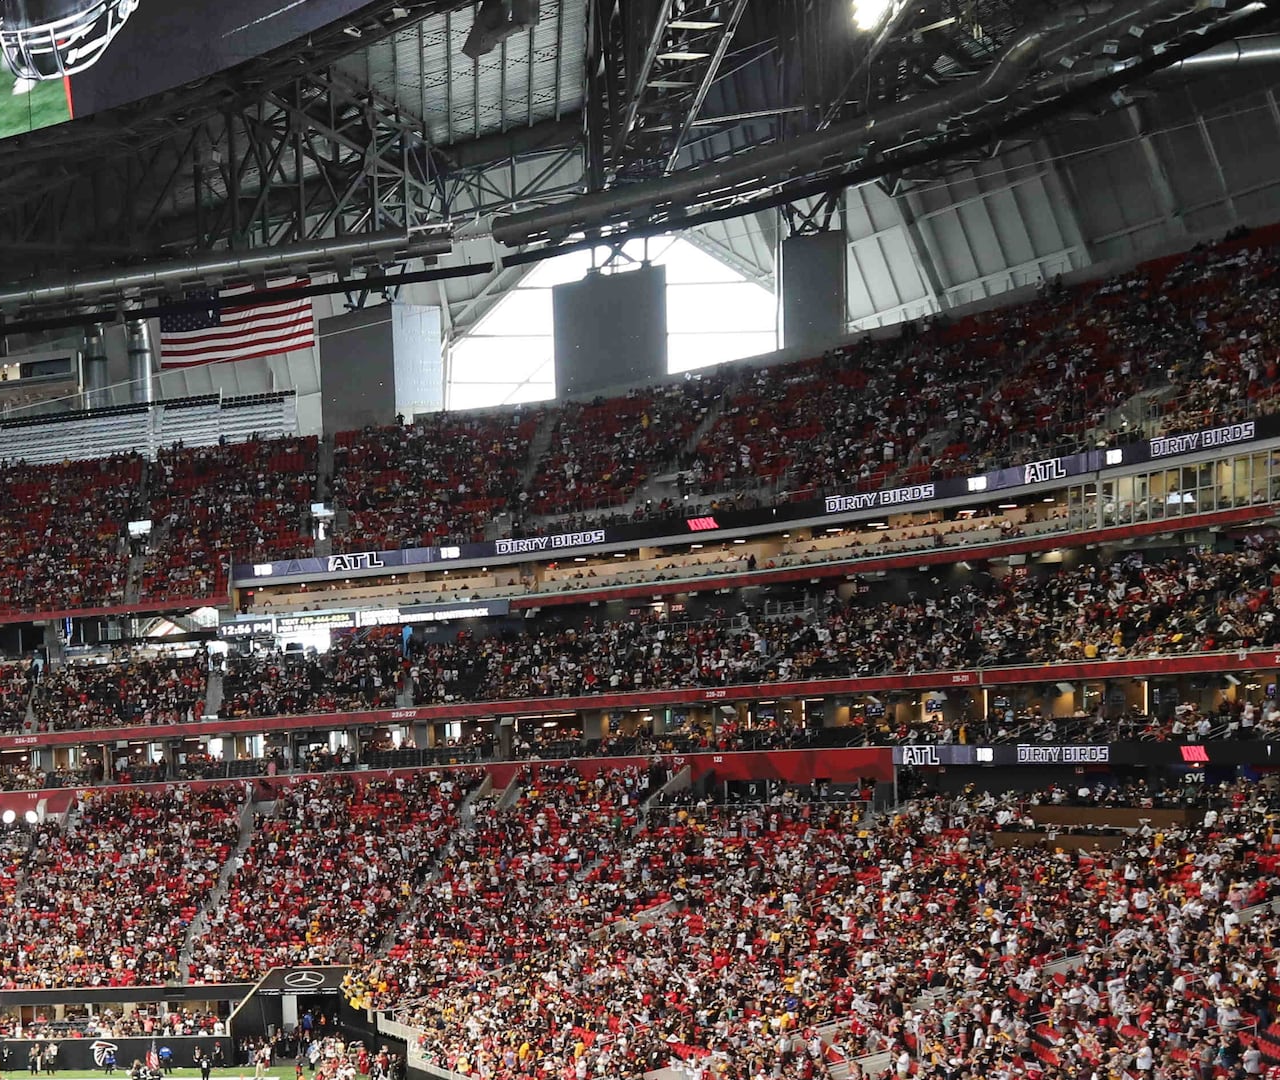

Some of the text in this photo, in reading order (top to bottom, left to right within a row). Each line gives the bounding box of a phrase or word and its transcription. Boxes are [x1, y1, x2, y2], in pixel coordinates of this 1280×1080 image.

[1150, 421, 1255, 458] DIRTY BIRDS
[1025, 457, 1067, 484] ATL
[826, 484, 935, 513] DIRTY BIRDS
[687, 516, 720, 531] KIRK
[496, 530, 605, 554] DIRTY BIRDS
[328, 552, 384, 571] ATL
[221, 624, 251, 635] 12:56
[252, 622, 272, 633] PM
[903, 746, 940, 766] ATL
[1017, 744, 1109, 762] DIRTY BIRDS
[1180, 746, 1208, 762] KIRK
